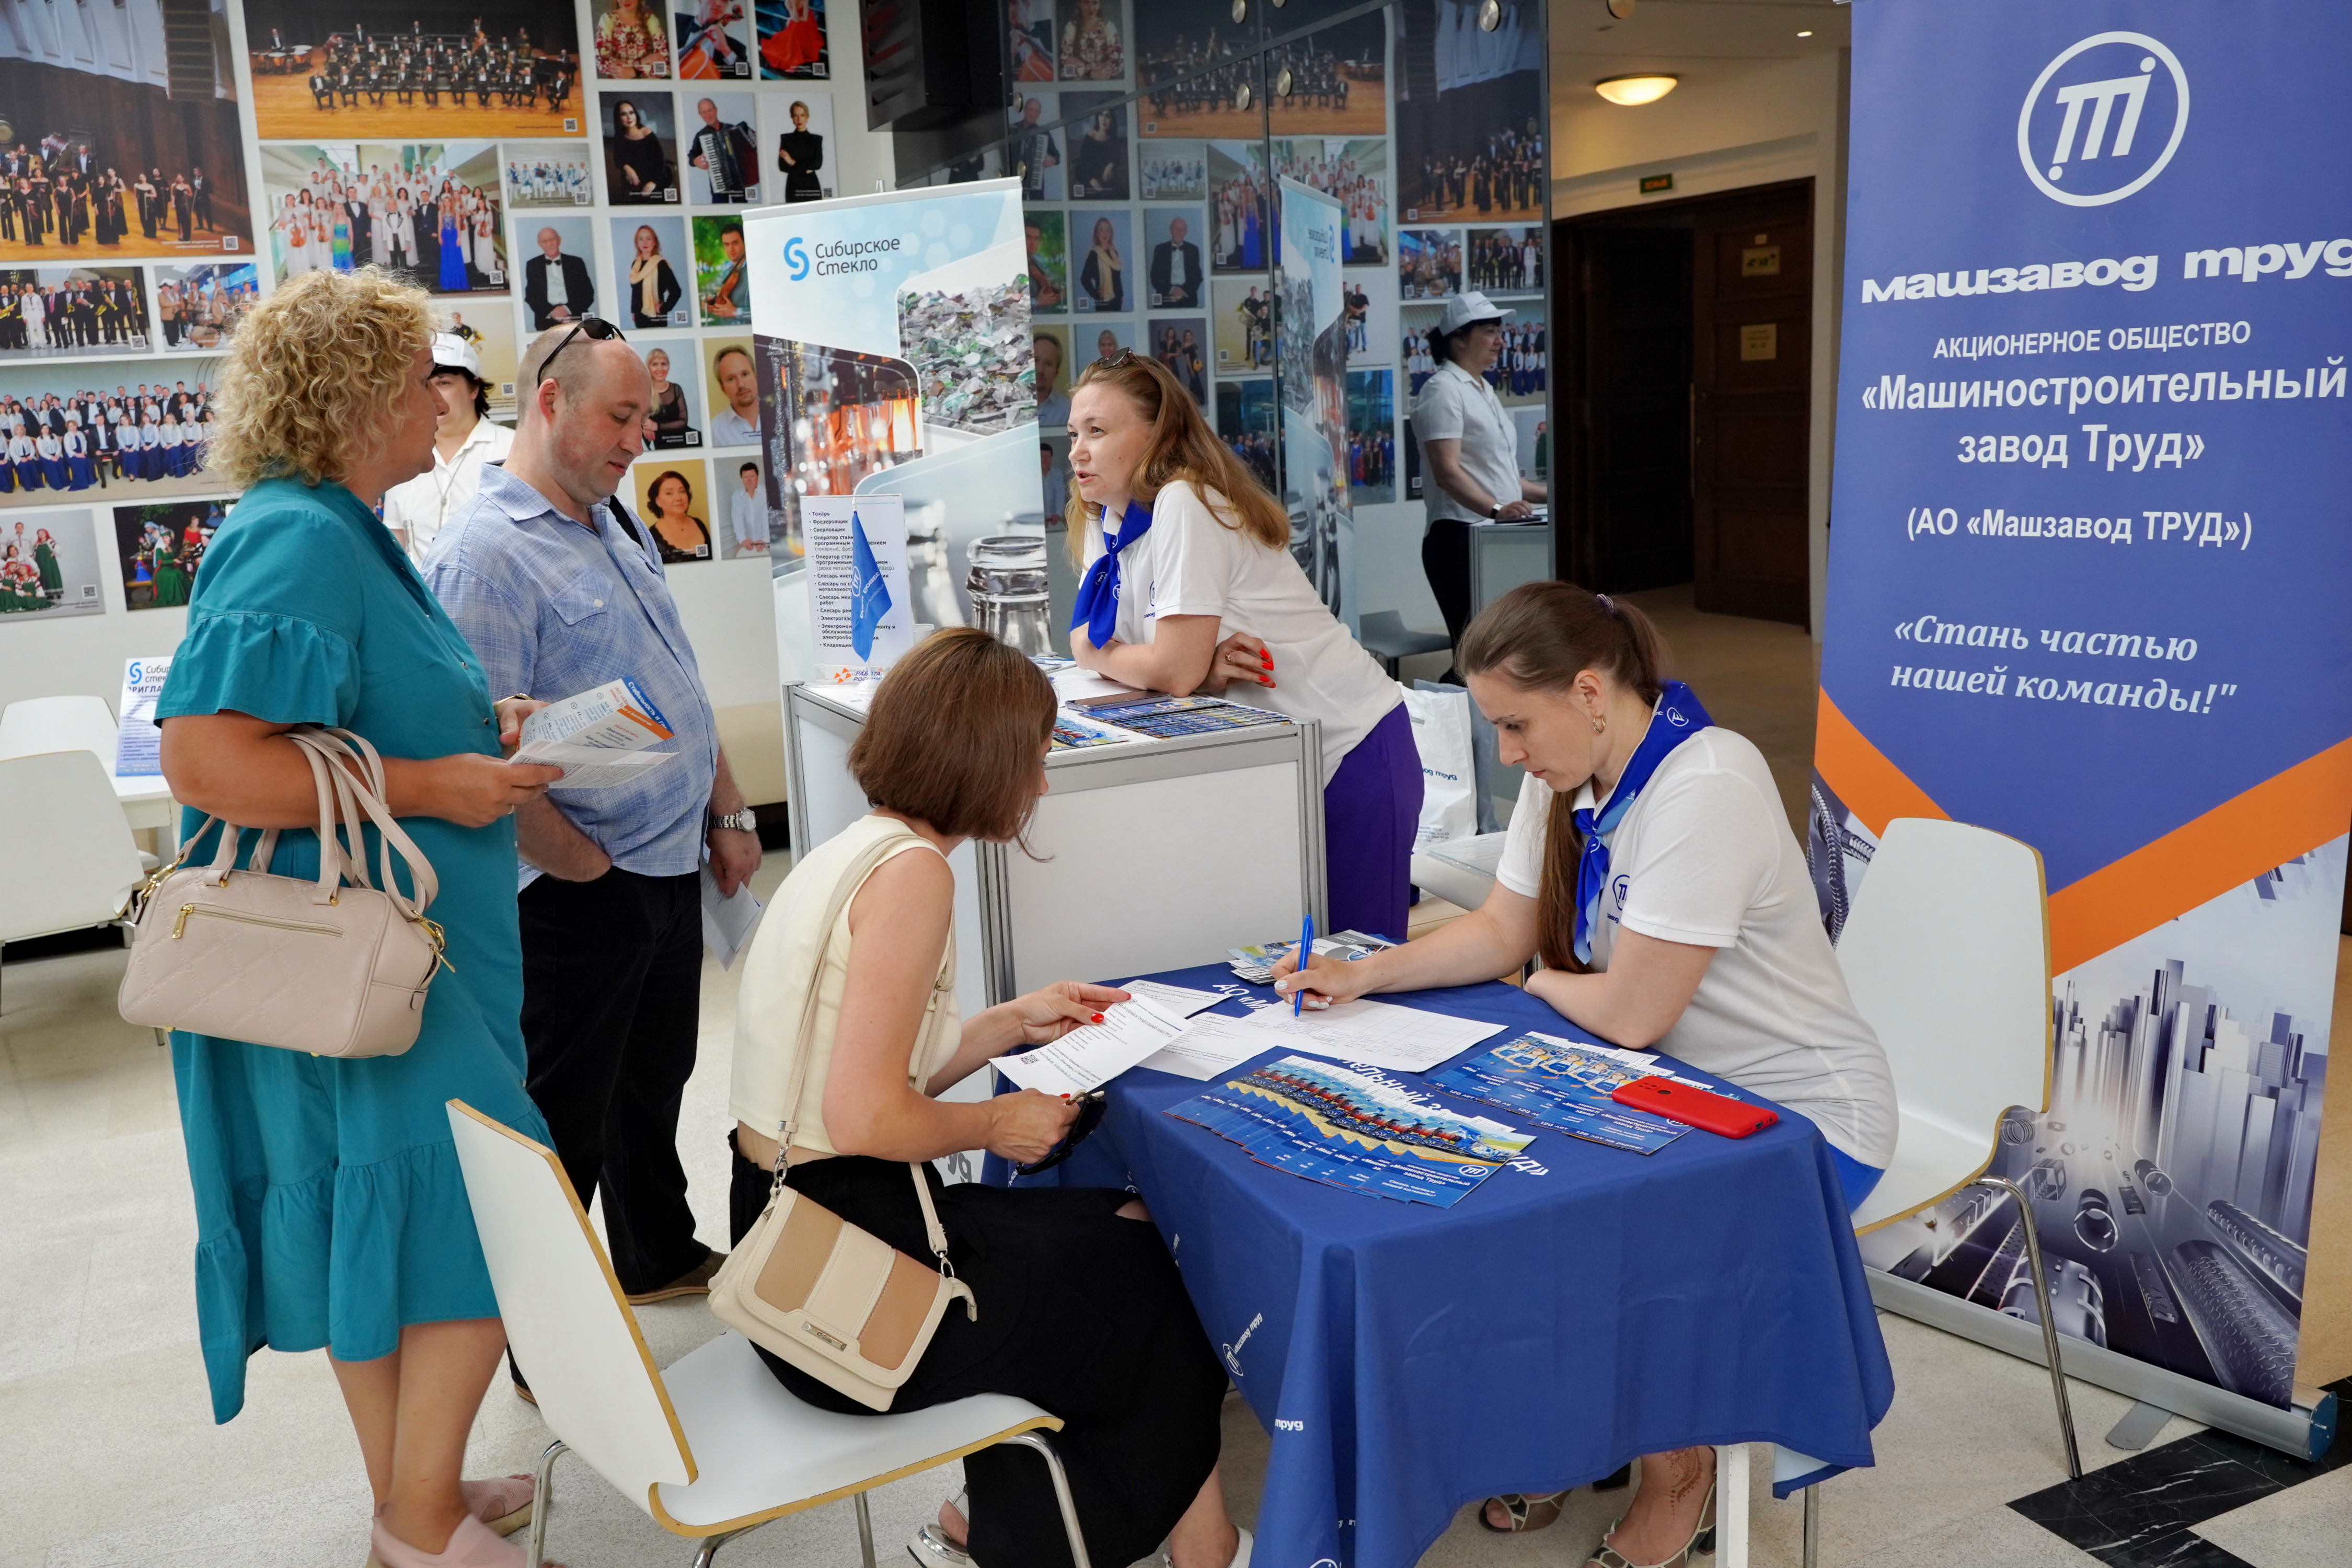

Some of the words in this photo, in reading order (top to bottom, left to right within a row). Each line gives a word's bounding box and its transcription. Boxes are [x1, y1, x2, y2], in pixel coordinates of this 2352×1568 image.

[815, 237, 900, 262] Сибирское
[816, 258, 878, 276] Стекло
[1933, 330, 2101, 360] АКЦИОНЕРНОЕ
[2107, 320, 2251, 354] ОБЩЕСТВО
[1862, 355, 2347, 414] «Машиностроительный
[1957, 432, 2068, 468] завод
[2082, 424, 2205, 471] Труд»
[1907, 508, 1958, 541] (АО
[1967, 509, 2132, 544] «Машзавод
[2142, 511, 2253, 549] ТРУД»)
[1894, 615, 2028, 651] «Стань
[2040, 629, 2197, 661] частью
[1890, 665, 2008, 695] нашей
[628, 681, 655, 716] Стабильность
[1212, 984, 1250, 996] АО
[1601, 1113, 1678, 1135] «Машиностроительный
[1613, 1120, 1633, 1129] завод
[1616, 1140, 1643, 1149] рынке!
[1381, 1182, 1404, 1191] нашей
[1390, 1165, 1471, 1186] «Машиностроительный
[1403, 1171, 1425, 1182] завод
[1425, 1176, 1446, 1185] Труд»
